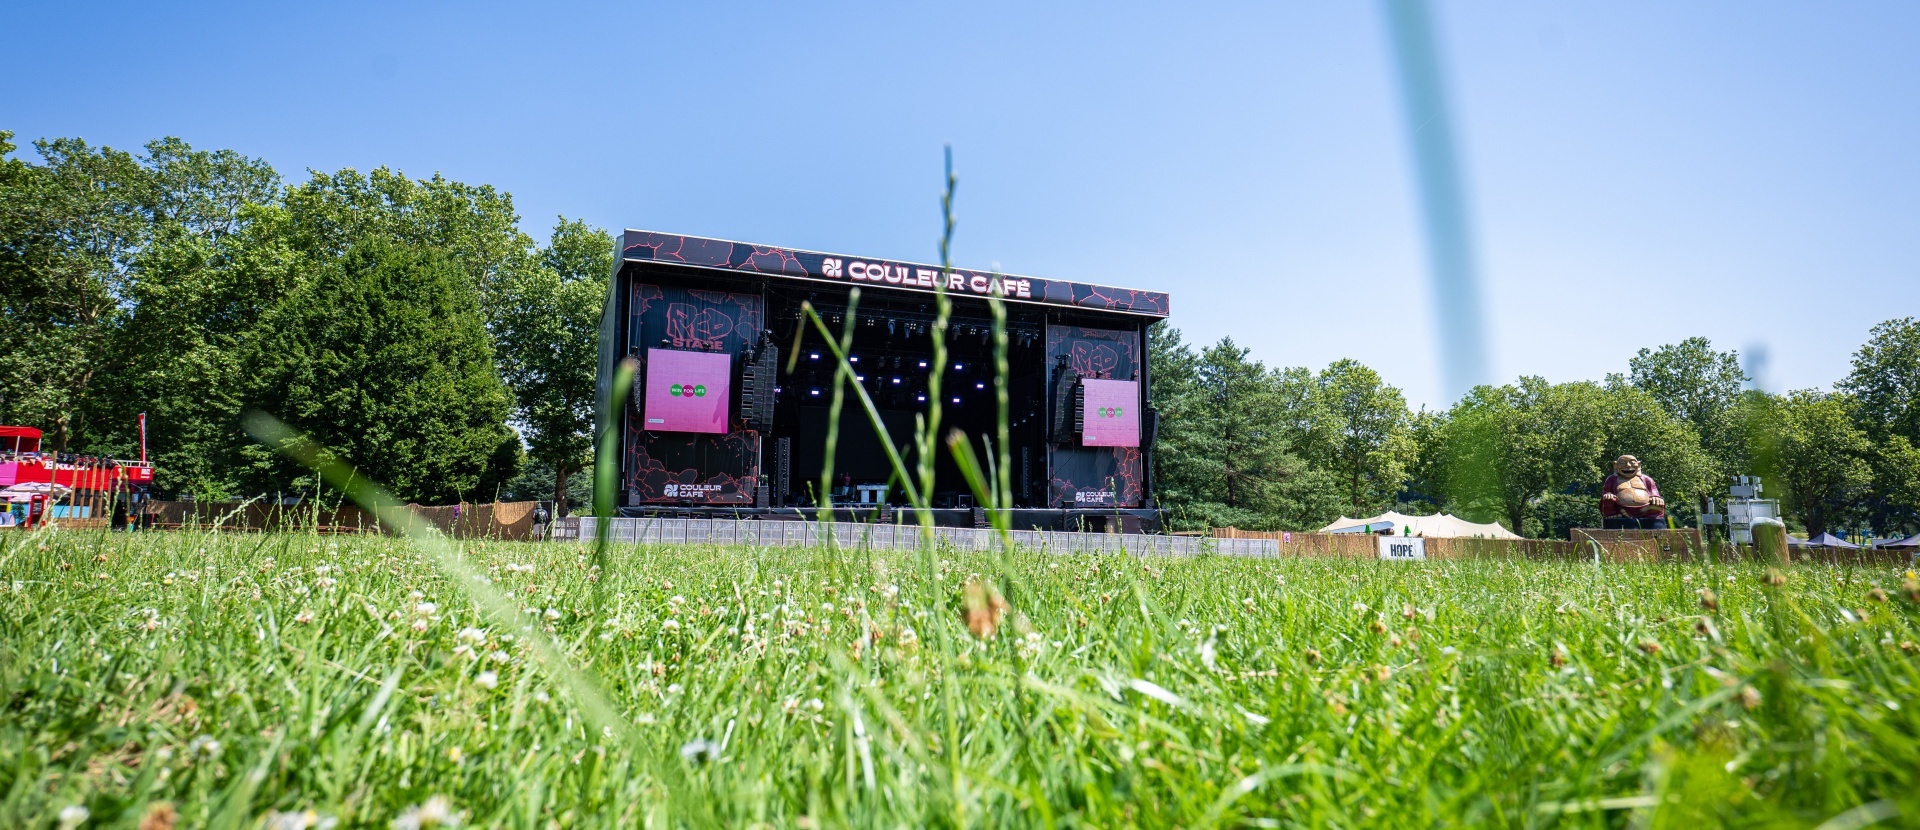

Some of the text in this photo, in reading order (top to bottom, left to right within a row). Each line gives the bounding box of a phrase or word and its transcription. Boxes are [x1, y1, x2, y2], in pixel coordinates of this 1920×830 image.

[848, 261, 1031, 298] COULEUR CAFÉ
[679, 484, 722, 492] COULEUR
[1390, 544, 1414, 558] HOPE
